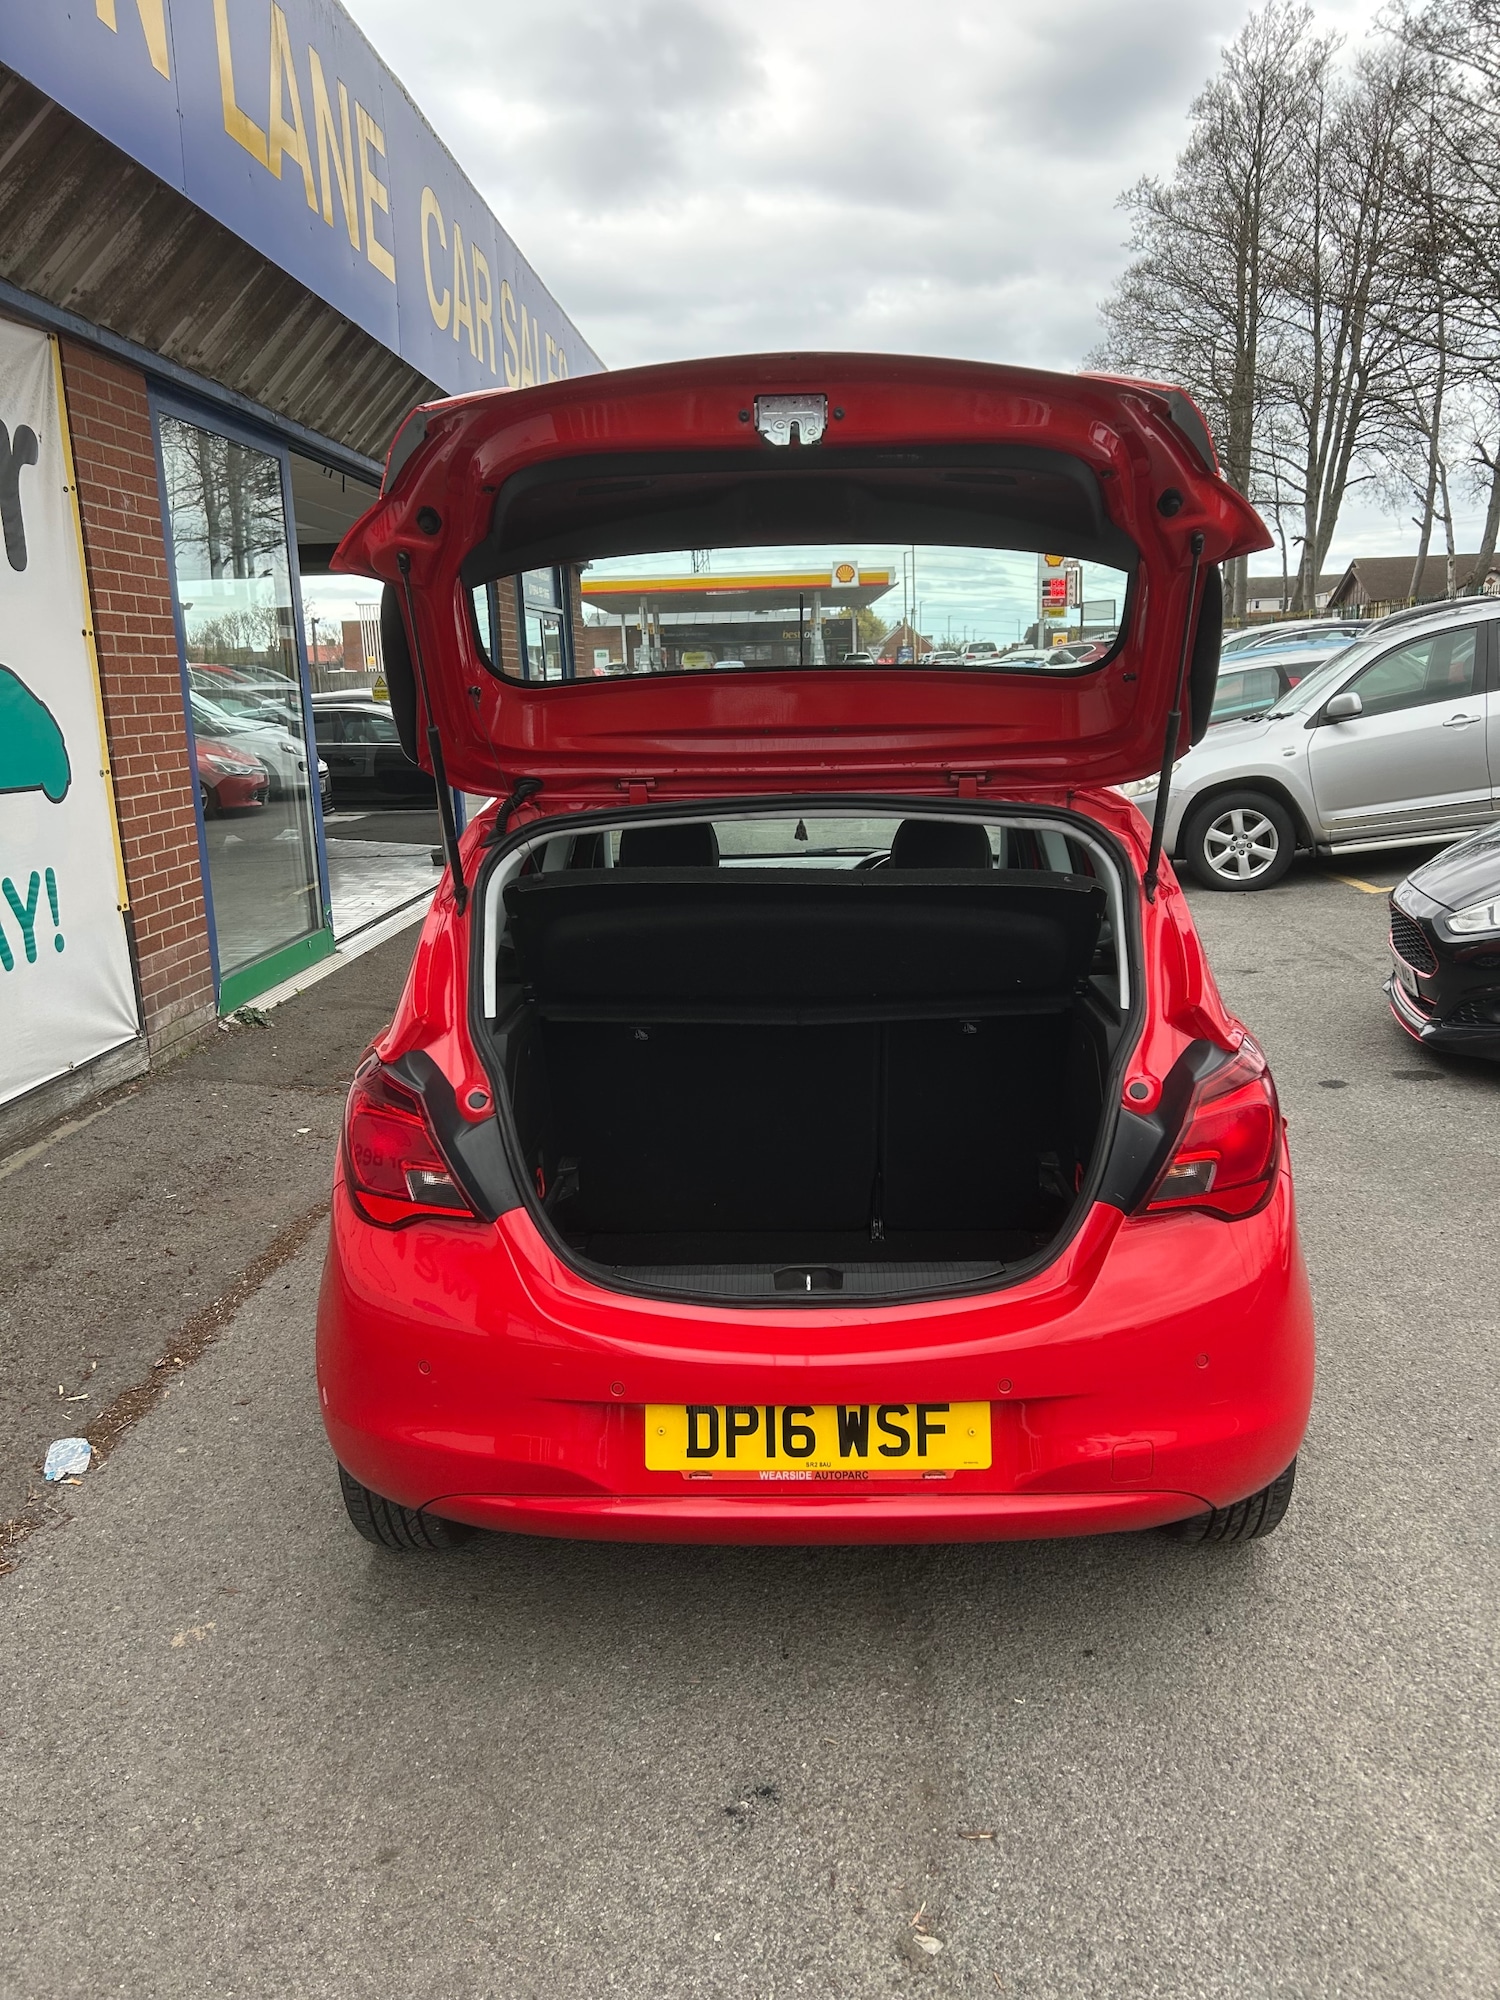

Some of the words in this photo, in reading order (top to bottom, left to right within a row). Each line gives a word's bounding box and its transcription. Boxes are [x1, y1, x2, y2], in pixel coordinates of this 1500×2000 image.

[213, 0, 396, 285] LANE
[420, 185, 497, 375] CAR
[686, 1405, 816, 1458] DP16
[836, 1403, 950, 1458] WSF
[759, 1470, 813, 1480] WEARSIDE
[814, 1470, 869, 1480] AUTOPARC
